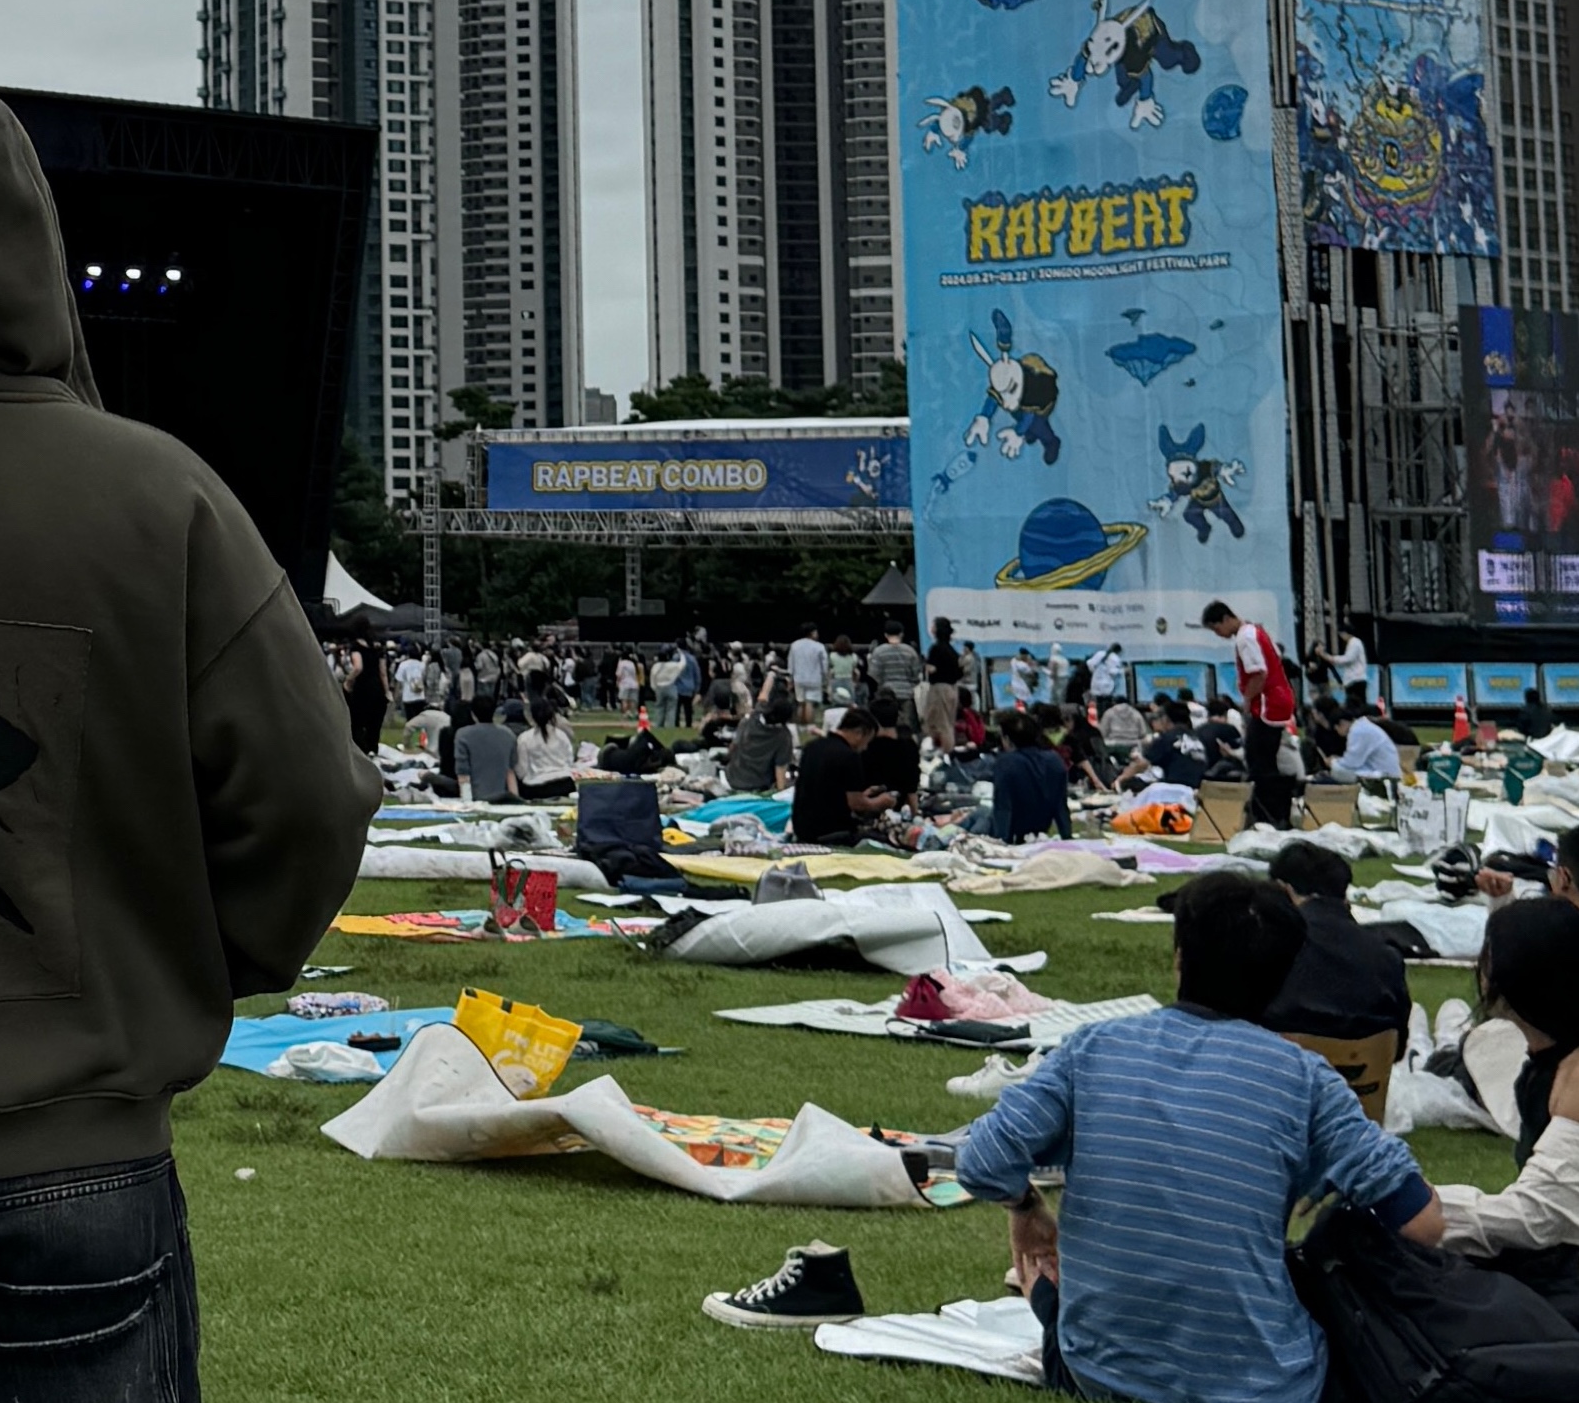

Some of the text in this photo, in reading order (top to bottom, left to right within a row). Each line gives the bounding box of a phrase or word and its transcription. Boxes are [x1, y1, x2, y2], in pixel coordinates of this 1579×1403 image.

[967, 182, 1195, 261] RAPBEAT
[1082, 259, 1144, 277] MOONLIGHT
[1146, 256, 1197, 271] FESTIVAL
[1199, 254, 1229, 268] PARK
[536, 462, 765, 489] RAPBEAT COMBO
